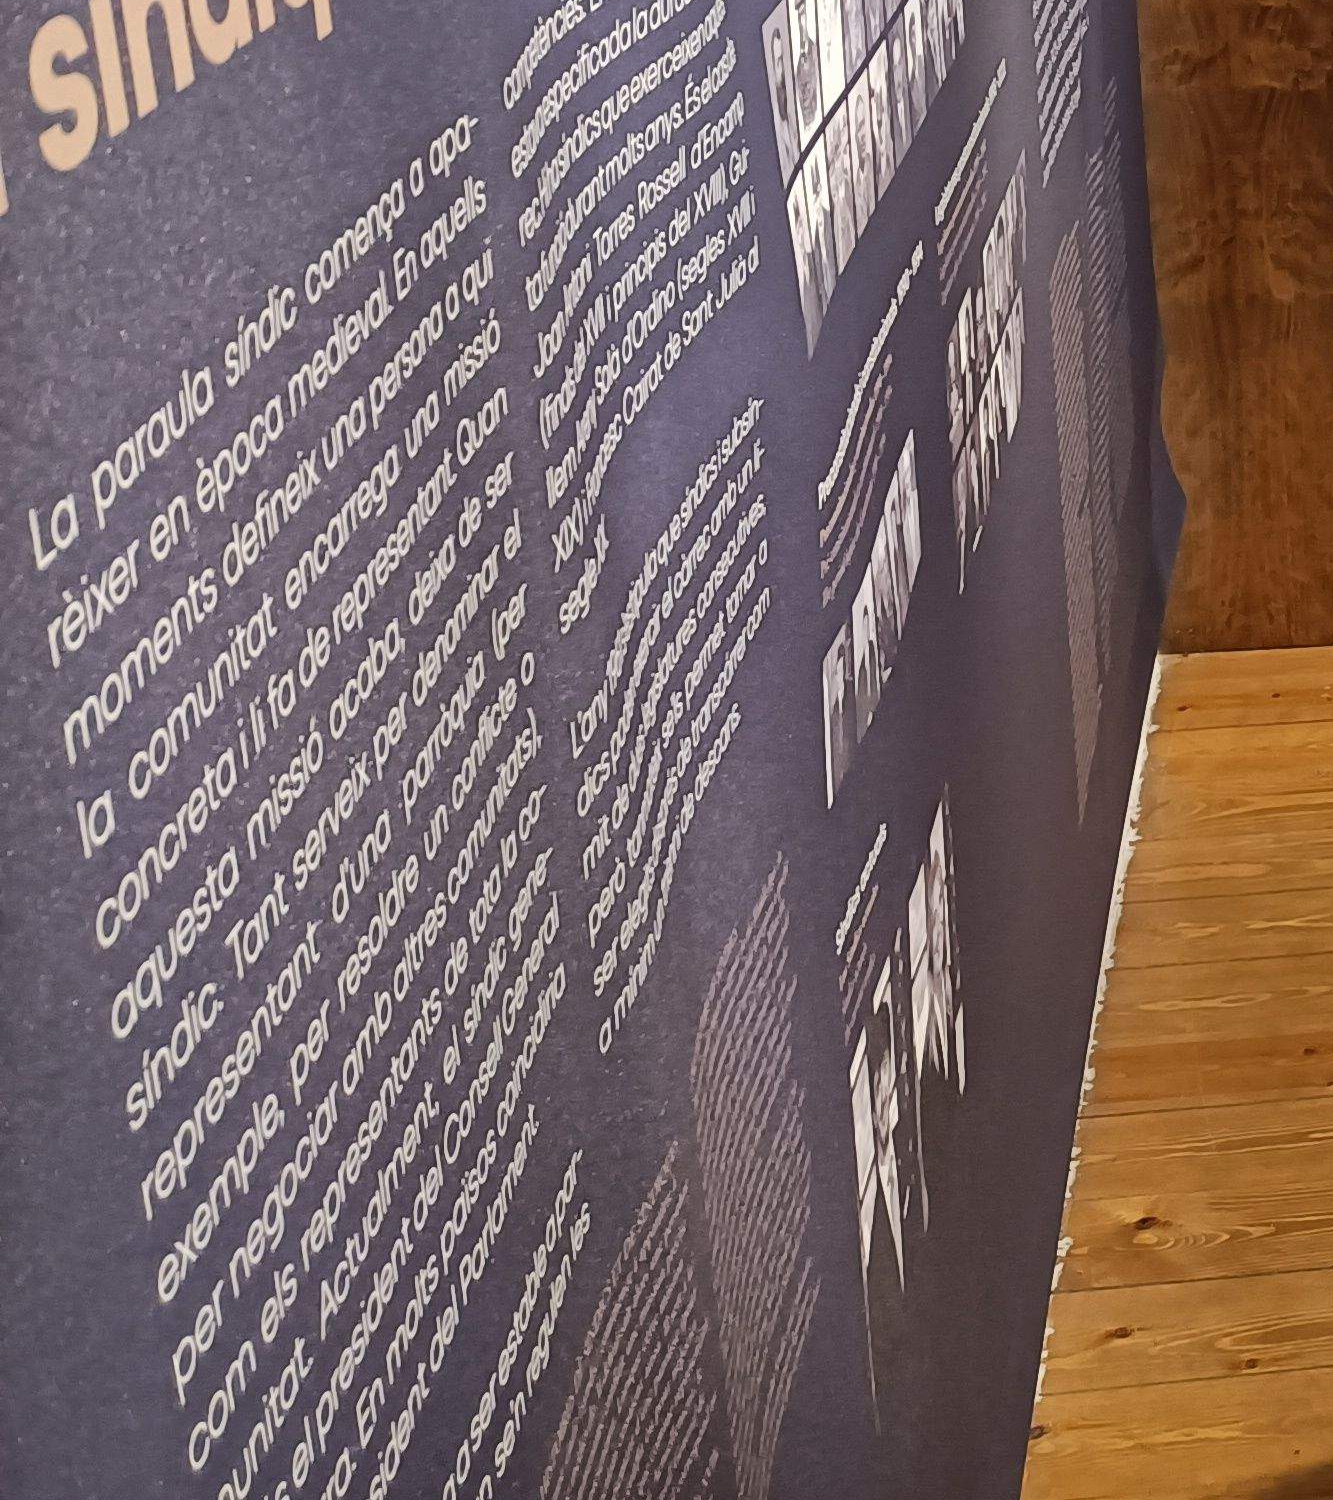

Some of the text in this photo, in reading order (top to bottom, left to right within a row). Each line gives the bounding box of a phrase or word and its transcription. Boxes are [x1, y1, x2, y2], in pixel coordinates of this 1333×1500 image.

[542, 19, 631, 122] especificada
[630, 7, 648, 43] la
[565, 165, 607, 240] durant
[605, 132, 645, 191] molts
[685, 73, 701, 120] És
[701, 65, 713, 105] el
[601, 84, 630, 135] que
[630, 21, 706, 104] exerceixen
[28, 115, 479, 571] La paraula síndic comença a apa-
[533, 310, 566, 378] Joan
[593, 204, 635, 267] Torres
[638, 145, 687, 220] Rossell
[613, 228, 666, 323] principis
[669, 197, 691, 247] del
[664, 330, 681, 371] de
[682, 290, 715, 346] Sant
[677, 229, 725, 301] (segles
[47, 175, 487, 669] rèixer en època medieval. En aquells
[63, 236, 493, 767] moments defineix una persona a qui
[657, 514, 681, 566] que
[662, 576, 674, 618] el
[711, 479, 736, 536] amb
[737, 459, 753, 493] un
[76, 307, 503, 860] la comunitat encarrega una missió
[95, 387, 509, 950] concreta i li fa de representant. Quan
[111, 451, 514, 1039] aquesta missió acaba, deixa de ser
[126, 507, 521, 1132] síndic. Tant serveix per denominar el
[583, 815, 611, 880] mit
[141, 583, 526, 1221] representant d'una parròquia (per
[158, 652, 534, 1302] exemple, per resoldre un conflicte o
[589, 856, 626, 949] però
[594, 936, 618, 997] ser
[172, 706, 543, 1406] per negociar amb altres comunitats),
[189, 784, 548, 1471] com els representants de tota la co-
[320, 1081, 439, 1341] Actualment,
[443, 1024, 460, 1085] el
[464, 936, 507, 1044] síndic
[509, 847, 553, 952] gene-
[599, 1017, 612, 1054] a
[292, 1415, 314, 1488] el
[315, 1217, 413, 1453] president
[413, 1145, 443, 1231] del
[443, 1015, 503, 1164] Consell
[502, 891, 559, 1036] General
[356, 962, 566, 1450] En molts països coincidiria
[430, 1104, 540, 1372] del Parlament.
[527, 1255, 571, 1397] regulen
[570, 1203, 590, 1260] les
[456, 1439, 471, 1485] a
[470, 1372, 498, 1453] ser
[498, 1243, 548, 1386] estable
